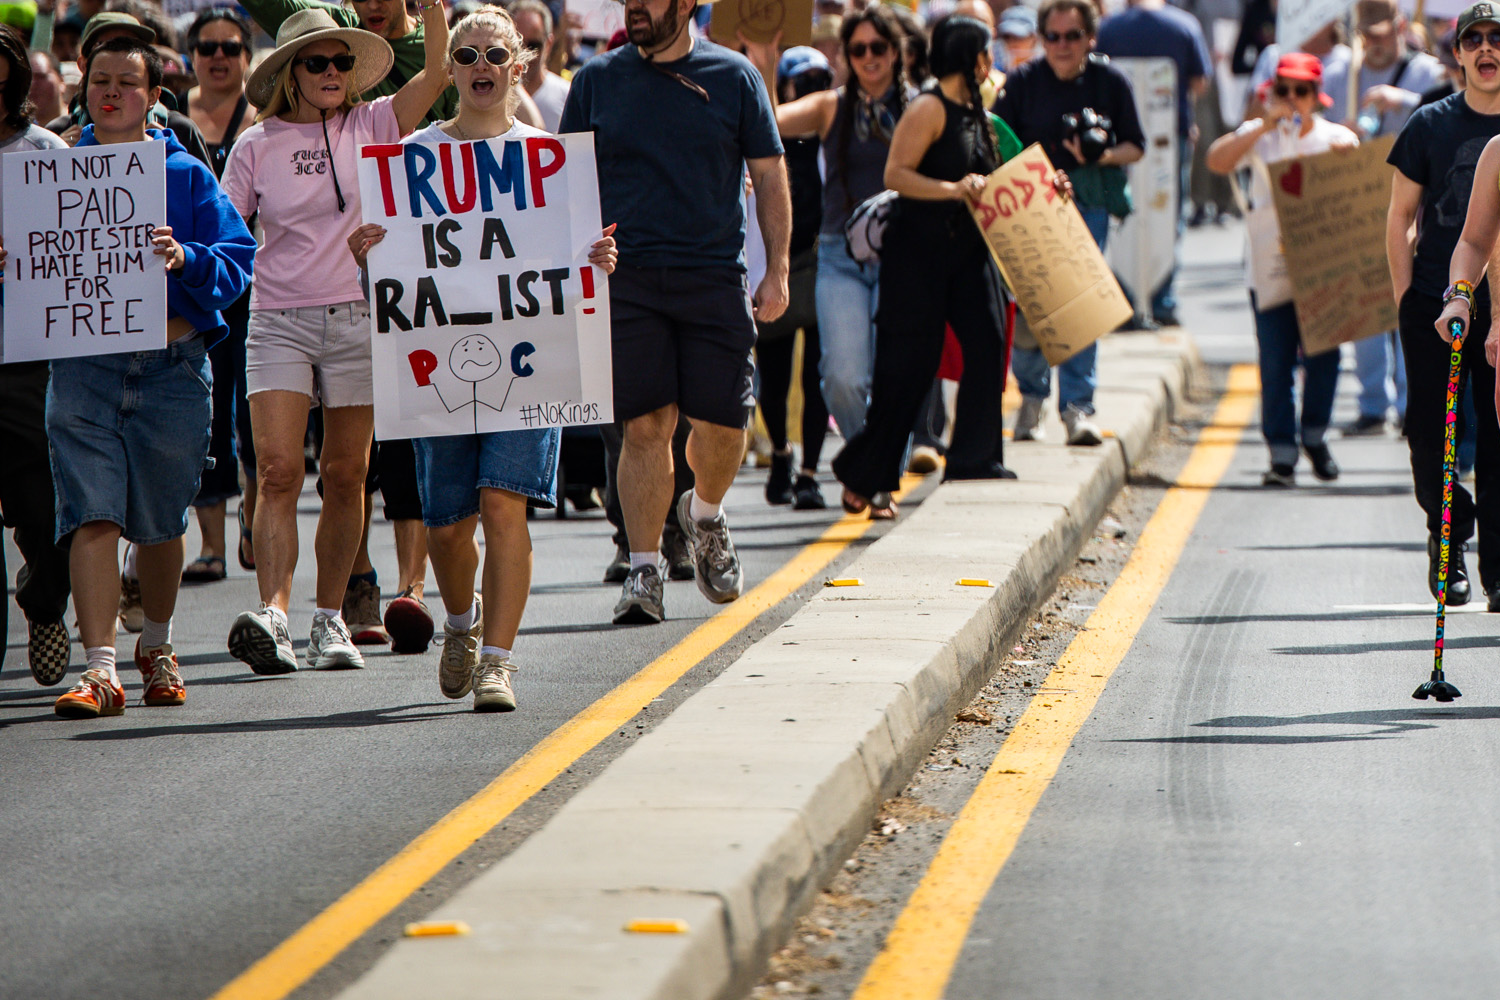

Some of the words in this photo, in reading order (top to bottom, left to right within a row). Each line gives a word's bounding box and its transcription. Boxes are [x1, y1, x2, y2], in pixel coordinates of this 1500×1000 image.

[24, 159, 58, 185] I'M
[71, 154, 117, 180] NOT
[125, 152, 145, 176] A
[293, 160, 327, 176] ICE
[361, 137, 567, 218] TRUMP
[57, 186, 135, 229] PAID
[28, 223, 156, 256] PROTESTER
[422, 217, 463, 269] IS
[479, 217, 516, 261] A
[15, 258, 22, 281] I
[31, 253, 84, 280] HATE
[97, 250, 145, 274] HIM
[64, 275, 113, 301] FOR
[45, 298, 145, 339] FREE
[407, 349, 438, 387] P
[510, 341, 537, 378] C
